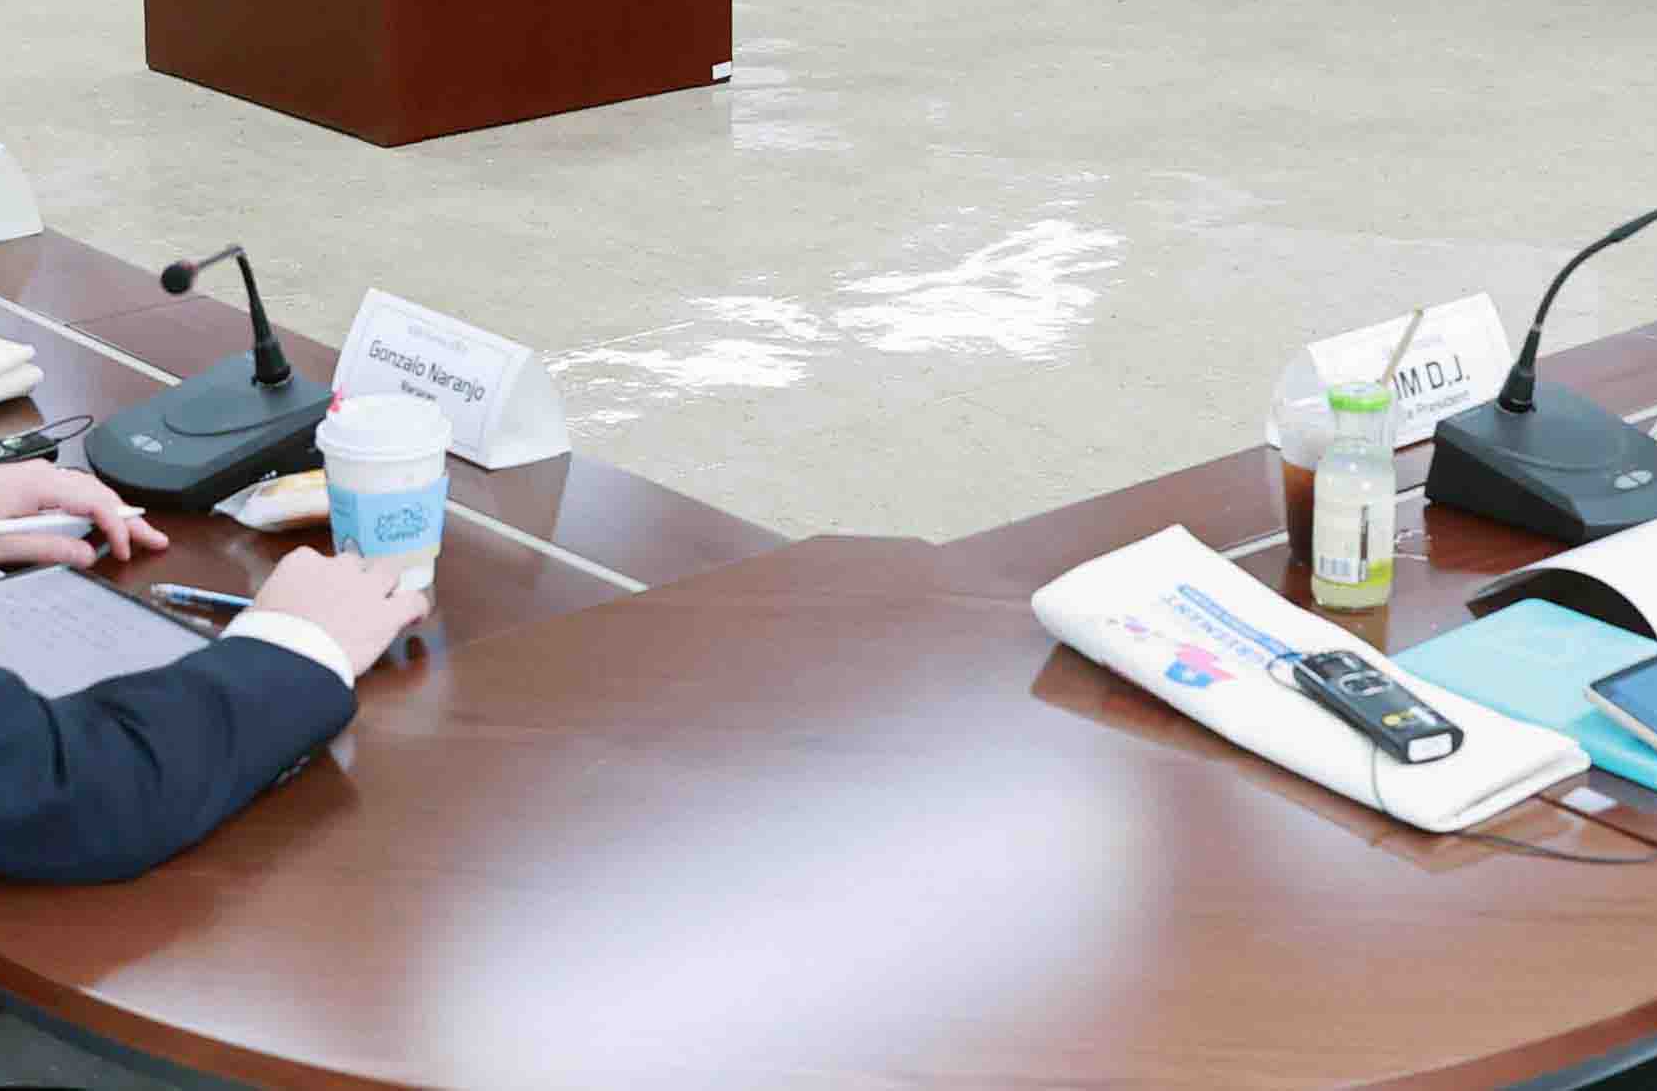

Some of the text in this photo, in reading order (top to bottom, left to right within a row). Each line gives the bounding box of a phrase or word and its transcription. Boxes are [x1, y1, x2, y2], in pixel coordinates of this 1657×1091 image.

[368, 339, 486, 403] Gonzalo Naranjo
[1392, 354, 1471, 401] IM D.J.
